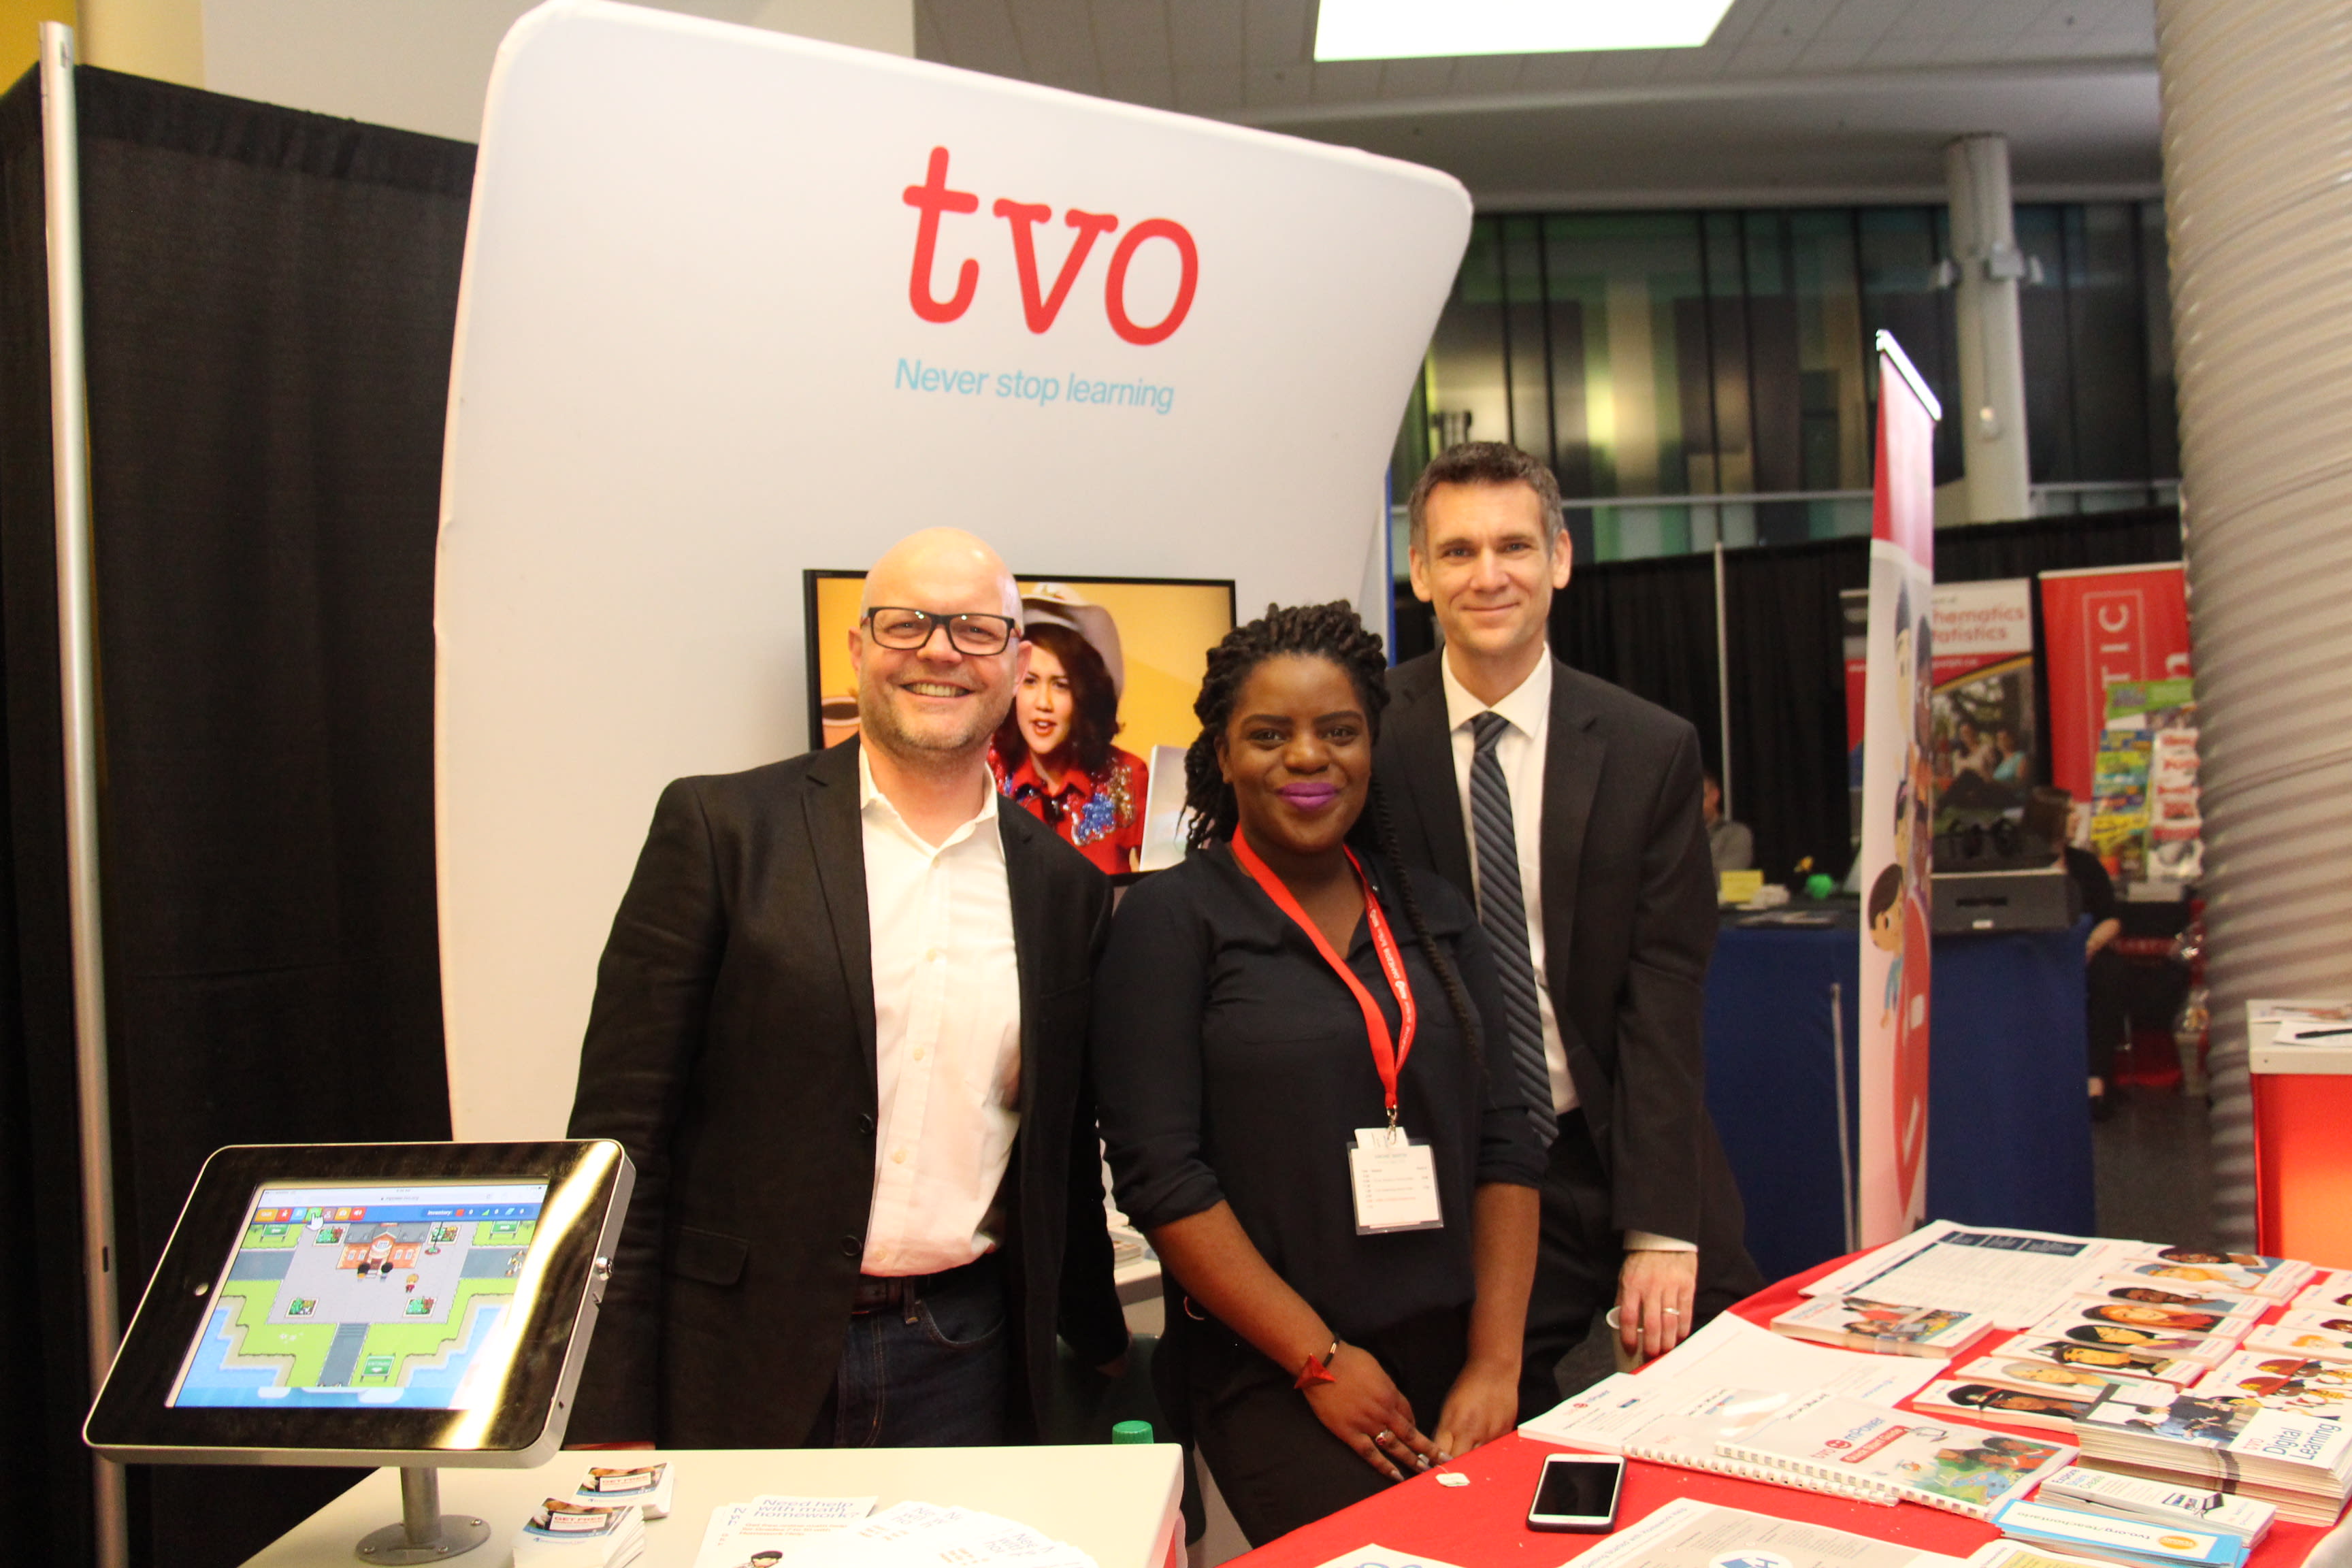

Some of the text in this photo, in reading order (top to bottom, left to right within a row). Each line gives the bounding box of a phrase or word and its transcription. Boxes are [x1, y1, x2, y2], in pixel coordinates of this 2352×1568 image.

[902, 146, 1198, 346] tvo
[894, 357, 1175, 415] Never stop learning
[1933, 605, 2025, 623] hematics
[2262, 1426, 2304, 1455] Digital
[2289, 1423, 2342, 1460] Learning
